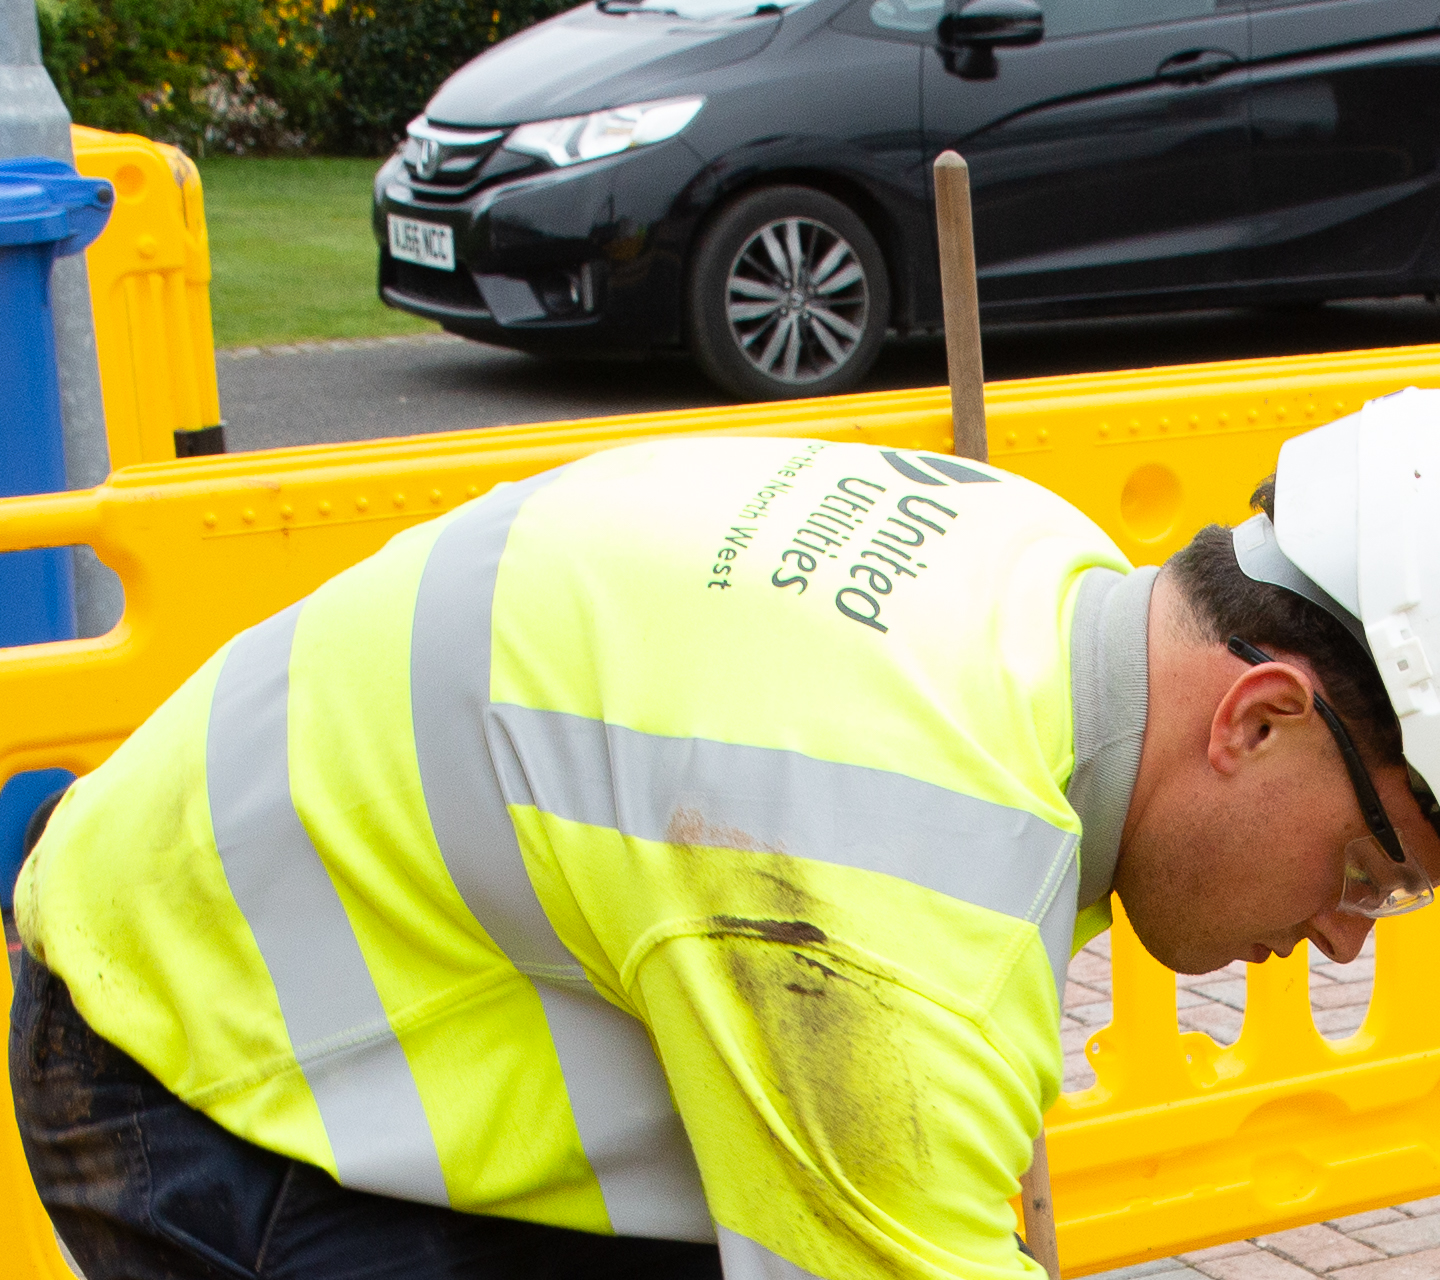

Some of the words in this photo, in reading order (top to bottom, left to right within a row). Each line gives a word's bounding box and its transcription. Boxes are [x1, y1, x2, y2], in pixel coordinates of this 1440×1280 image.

[738, 479, 794, 519] North
[777, 456, 814, 478] the
[707, 526, 758, 590] West
[771, 477, 887, 596] Utilities
[835, 495, 959, 634] United
